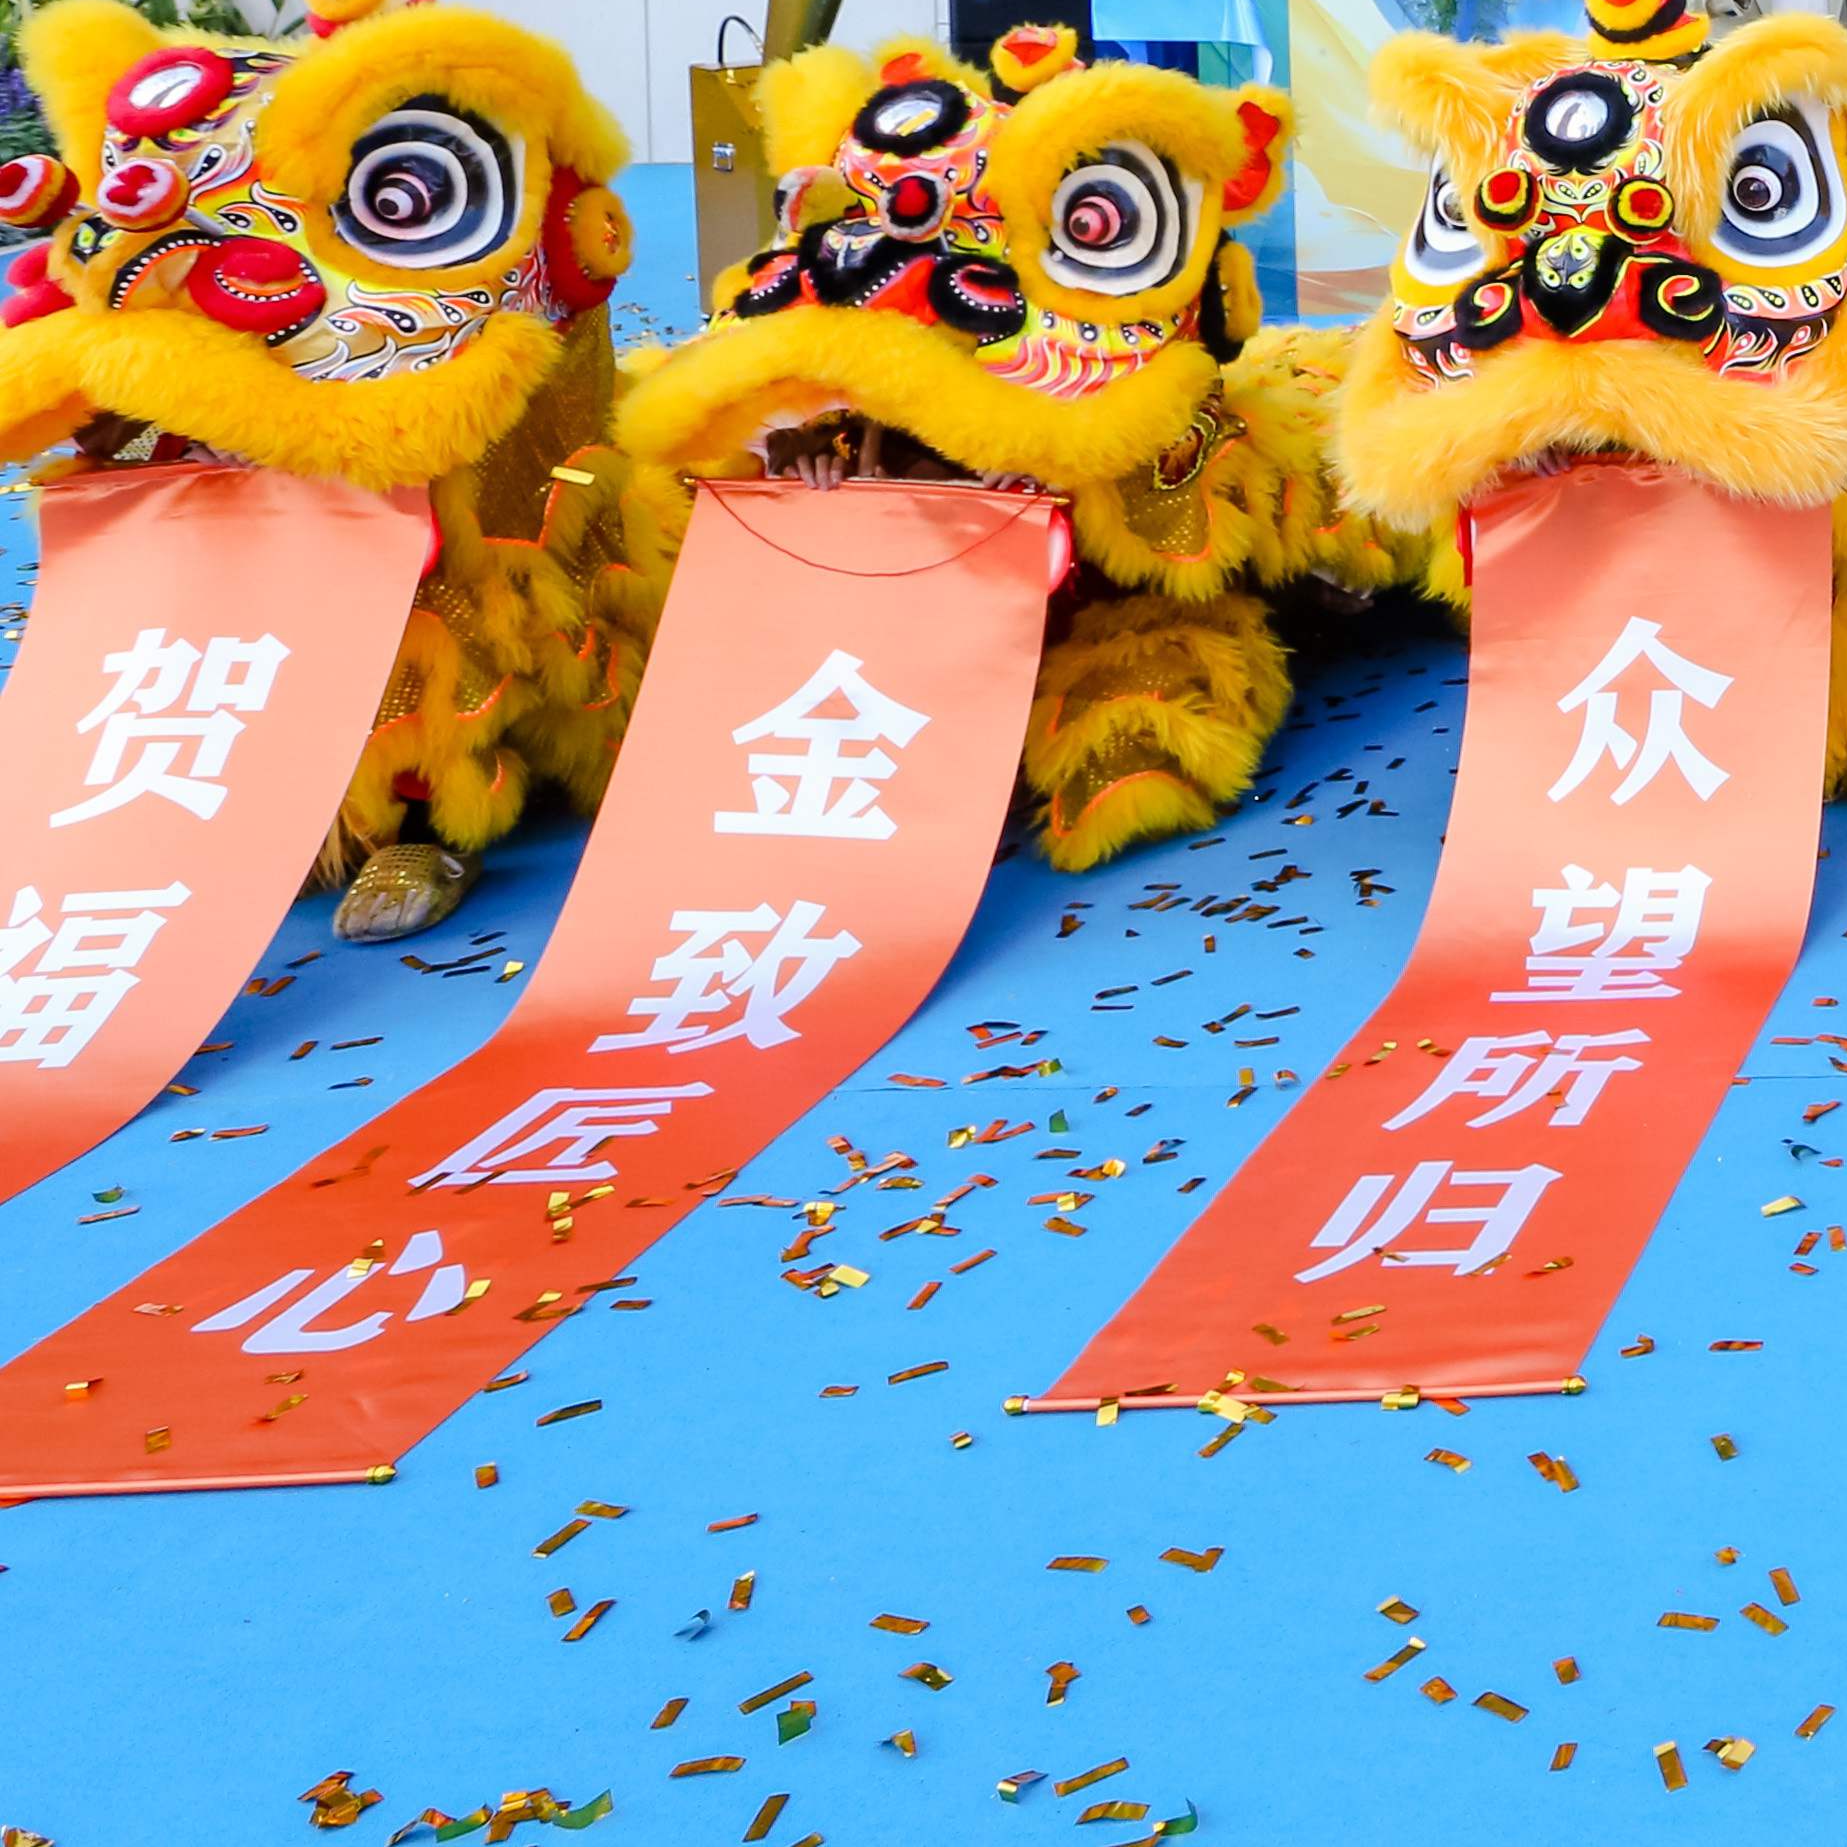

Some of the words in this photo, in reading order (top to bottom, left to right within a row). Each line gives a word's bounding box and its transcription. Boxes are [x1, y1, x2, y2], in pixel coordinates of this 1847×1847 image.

[0, 627, 292, 1069] 贺福
[190, 649, 932, 1354] 金致匠心
[1293, 615, 1735, 1285] 众望所归
